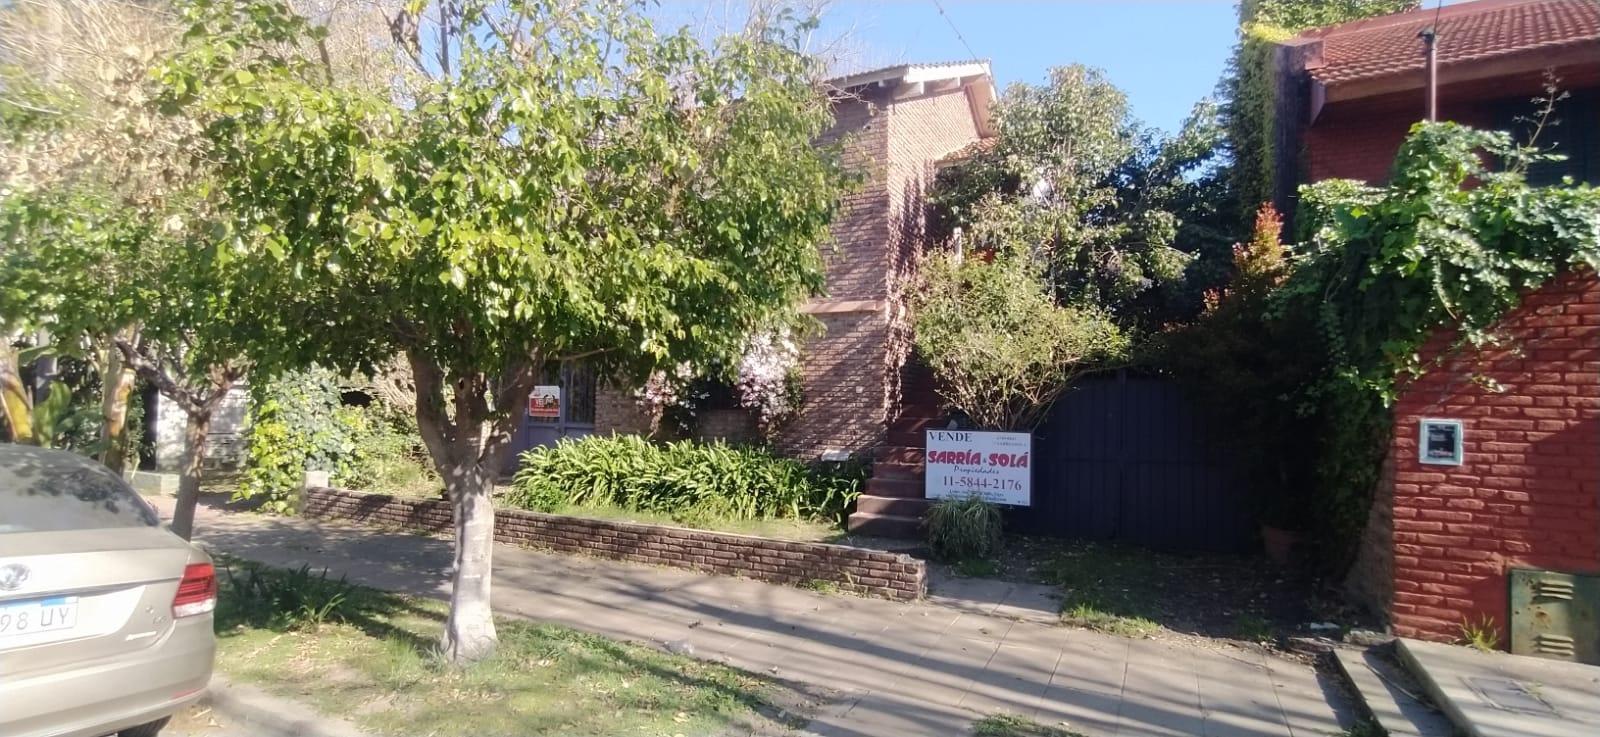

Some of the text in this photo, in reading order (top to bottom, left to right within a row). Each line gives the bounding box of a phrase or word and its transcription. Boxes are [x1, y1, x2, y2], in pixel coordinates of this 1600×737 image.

[929, 432, 972, 442] VENDE
[928, 449, 981, 465] SARRÍA
[988, 452, 1029, 468] SOLÁ
[954, 465, 1000, 474] Propiedades
[943, 475, 1022, 491] 11-5844-2176
[40, 607, 69, 627] UY
